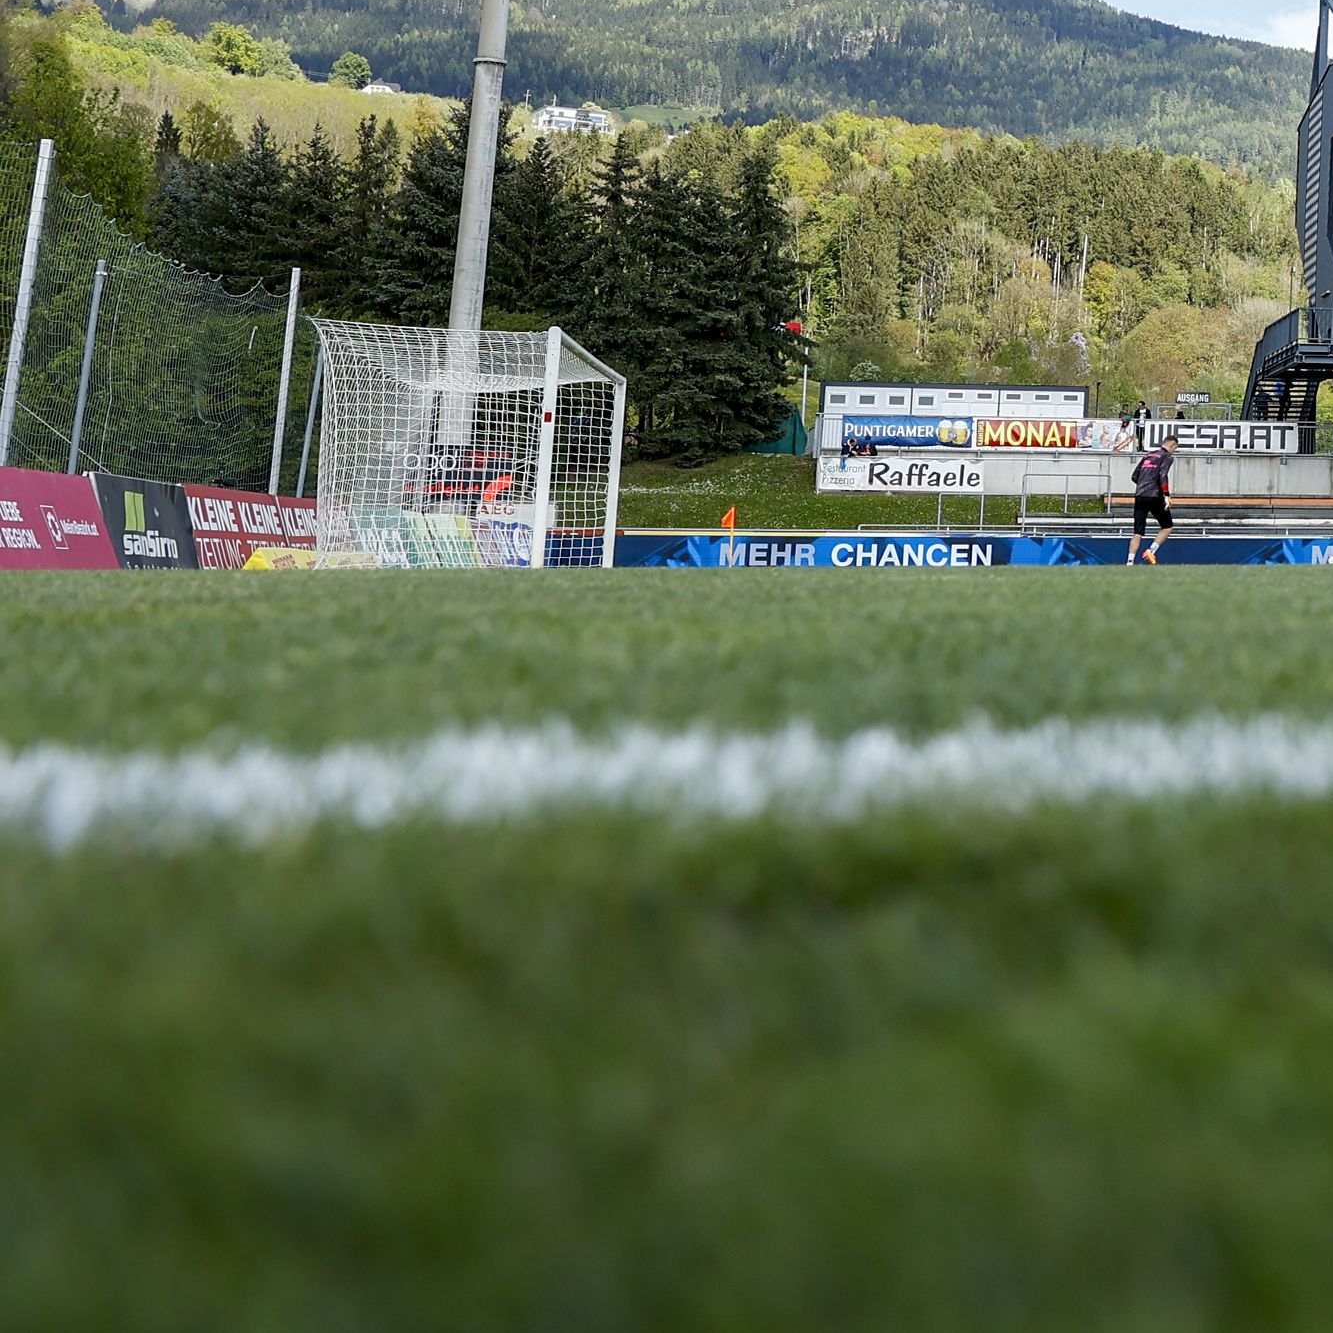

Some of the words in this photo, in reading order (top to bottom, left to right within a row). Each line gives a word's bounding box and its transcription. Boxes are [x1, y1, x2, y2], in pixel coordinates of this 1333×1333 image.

[1177, 393, 1210, 403] AUSGANG
[843, 423, 934, 437] PUNTIGAMER
[984, 421, 1075, 447] MONAT
[822, 475, 855, 485] Pizzeria
[868, 462, 980, 487] Raffaele
[187, 497, 239, 532] KLEINE
[238, 502, 282, 535] KLEINE
[2, 528, 42, 549] REGION.
[123, 530, 179, 559] sanSirro
[196, 538, 246, 570] ZEITUNG
[719, 543, 816, 566] MEHR
[831, 543, 993, 566] CHANCEN
